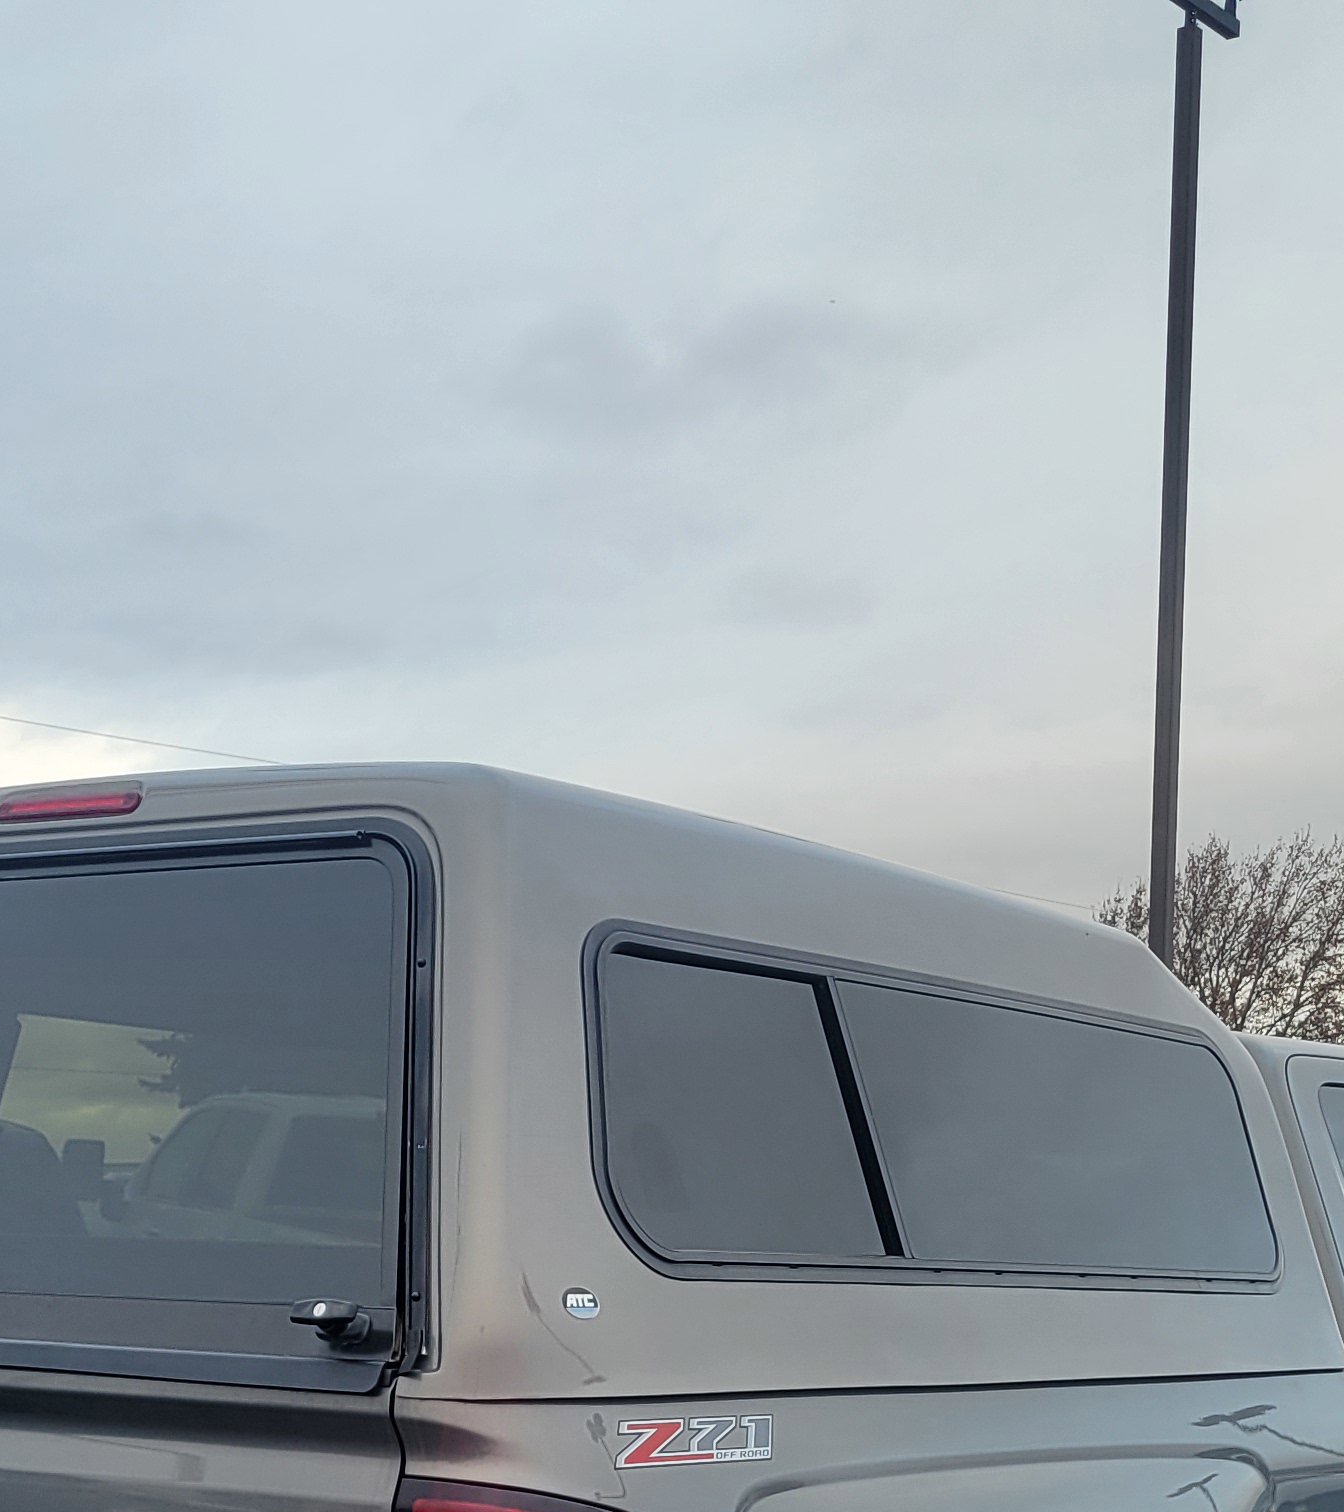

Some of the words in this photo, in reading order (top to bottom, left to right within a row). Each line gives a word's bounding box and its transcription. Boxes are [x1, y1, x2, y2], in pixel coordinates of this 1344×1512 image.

[566, 1293, 595, 1308] ATC
[614, 1413, 773, 1470] Z71
[716, 1450, 737, 1460] OFF
[739, 1448, 769, 1458] ROAD
